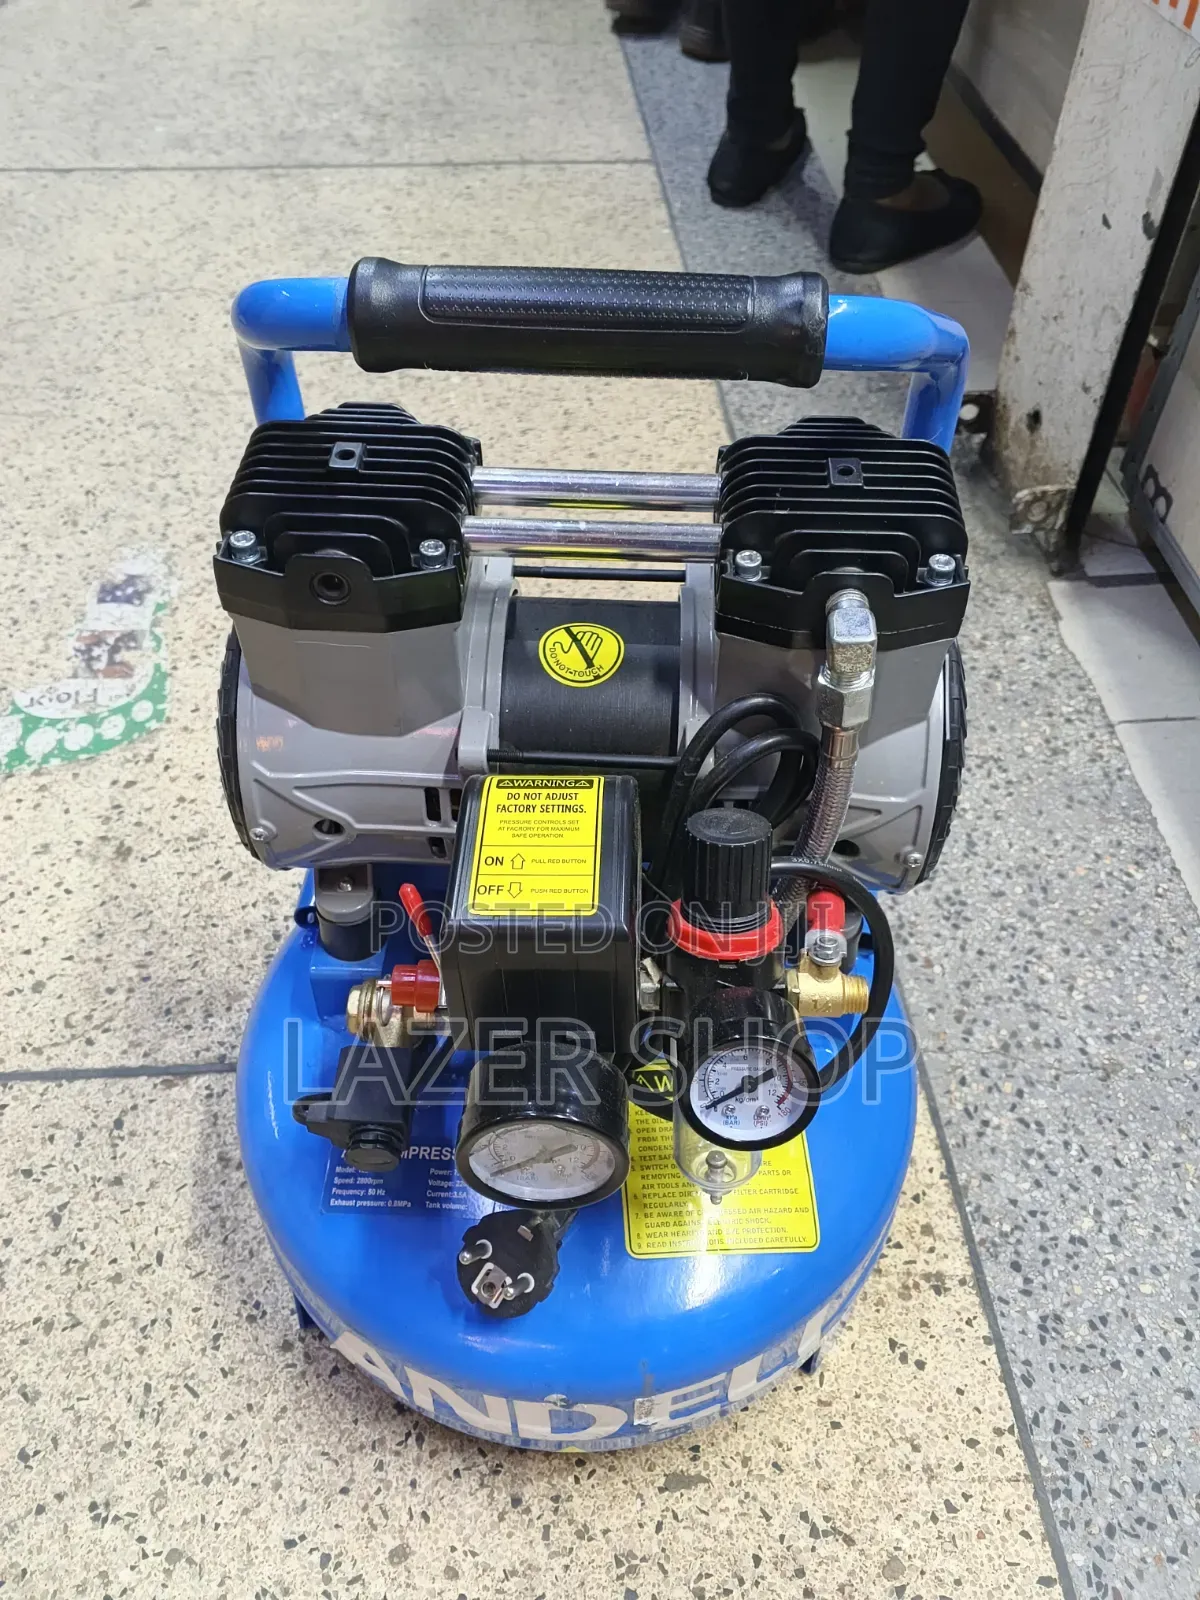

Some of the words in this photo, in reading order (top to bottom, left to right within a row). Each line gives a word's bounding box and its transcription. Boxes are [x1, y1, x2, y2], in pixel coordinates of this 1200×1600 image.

[507, 792, 521, 801] DO
[523, 792, 543, 801] NOT
[545, 792, 580, 801] ADJUST
[496, 804, 537, 813] FACTORY
[540, 804, 587, 813] SETTINGS.
[484, 856, 505, 866] ON
[477, 884, 505, 895] OFF
[639, 1154, 656, 1162] TEST
[639, 1163, 669, 1171] SWITCH
[429, 1168, 453, 1176] Power:
[640, 1172, 681, 1180] REMOVING
[333, 1176, 356, 1185] Speed:
[428, 1179, 455, 1188] Voltage:
[331, 1187, 367, 1197] Frequency:
[367, 1188, 376, 1196] 50
[376, 1188, 386, 1196] Hz
[642, 1191, 677, 1199] REPLACE
[759, 1187, 799, 1195] CARTRIDGE
[329, 1198, 356, 1206] Exhaust
[356, 1199, 387, 1208] pressure:
[425, 1201, 441, 1209] Tank
[441, 1202, 468, 1210] volume:
[656, 1210, 684, 1218] AWARE
[763, 1206, 793, 1214] HAZARD
[644, 1221, 671, 1229] GUARD
[645, 1231, 669, 1239] WEAR
[742, 1226, 789, 1234] PROTECTION.
[646, 1241, 668, 1249] READ
[765, 1235, 808, 1243] CAREFULLY.
